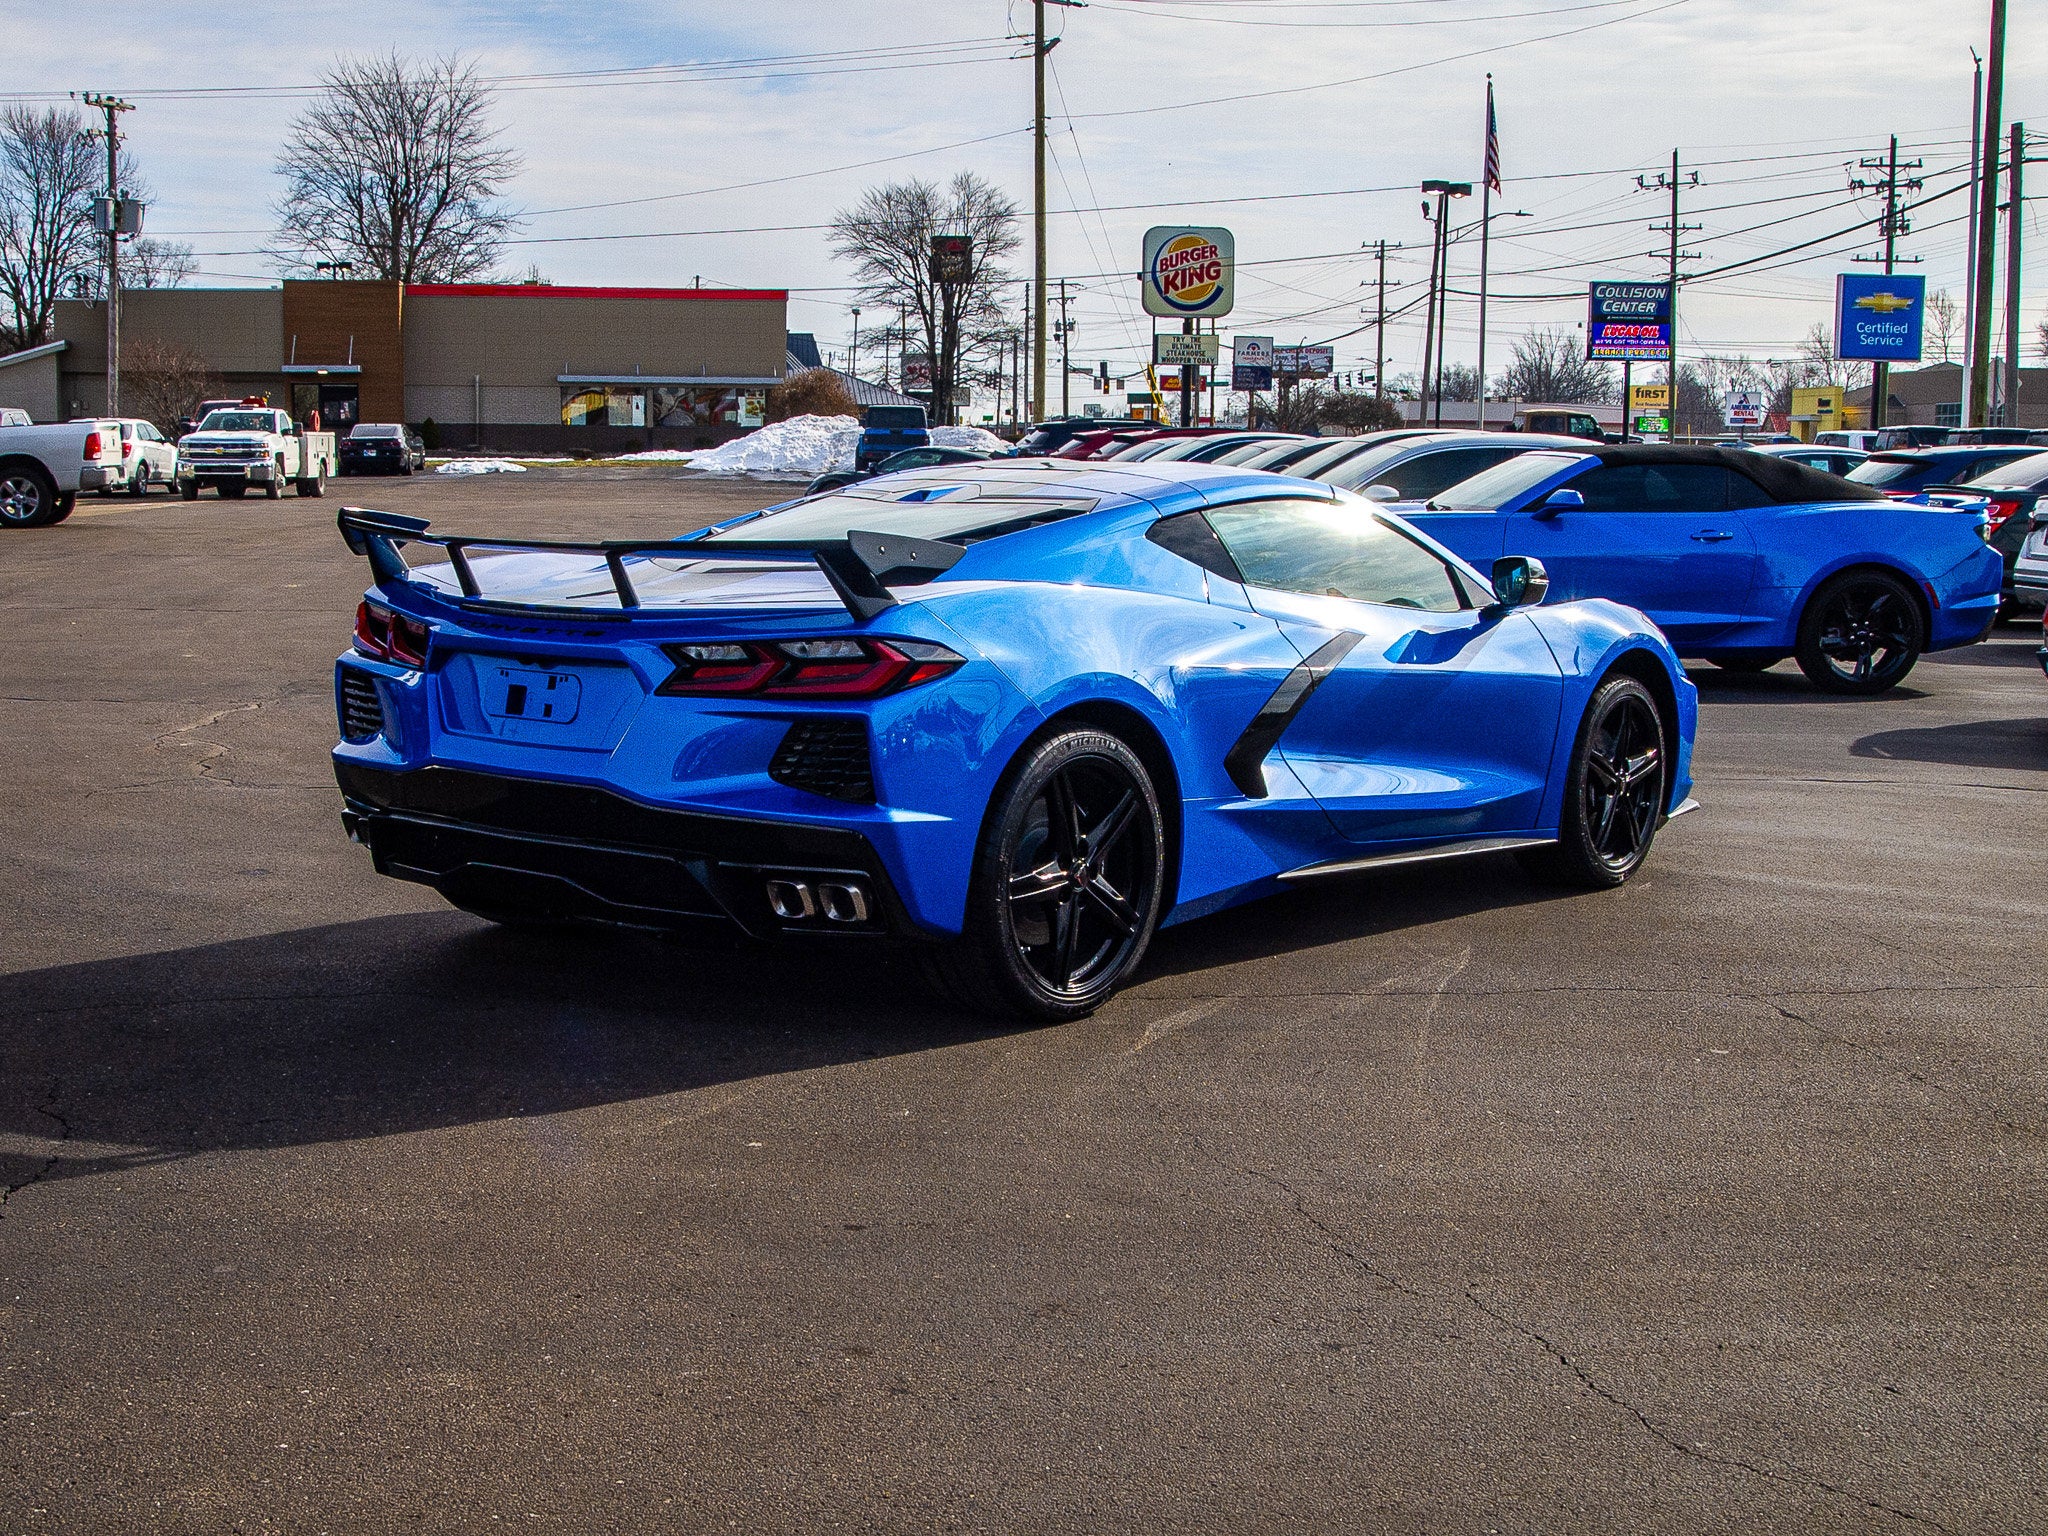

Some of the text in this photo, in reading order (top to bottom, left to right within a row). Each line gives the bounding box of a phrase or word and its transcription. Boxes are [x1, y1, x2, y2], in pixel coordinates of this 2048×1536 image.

[1159, 244, 1218, 274] BURGER
[1163, 260, 1222, 296] KING
[1596, 285, 1667, 299] COLLISION
[1602, 300, 1656, 313] CENTER
[1602, 324, 1660, 339] LUCAS OIL
[1856, 322, 1908, 334] Certified
[1860, 334, 1903, 346] Service
[1729, 403, 1759, 411] AMERICAN
[457, 618, 606, 637] CORVETTE
[1070, 737, 1117, 750] MICHELIN
